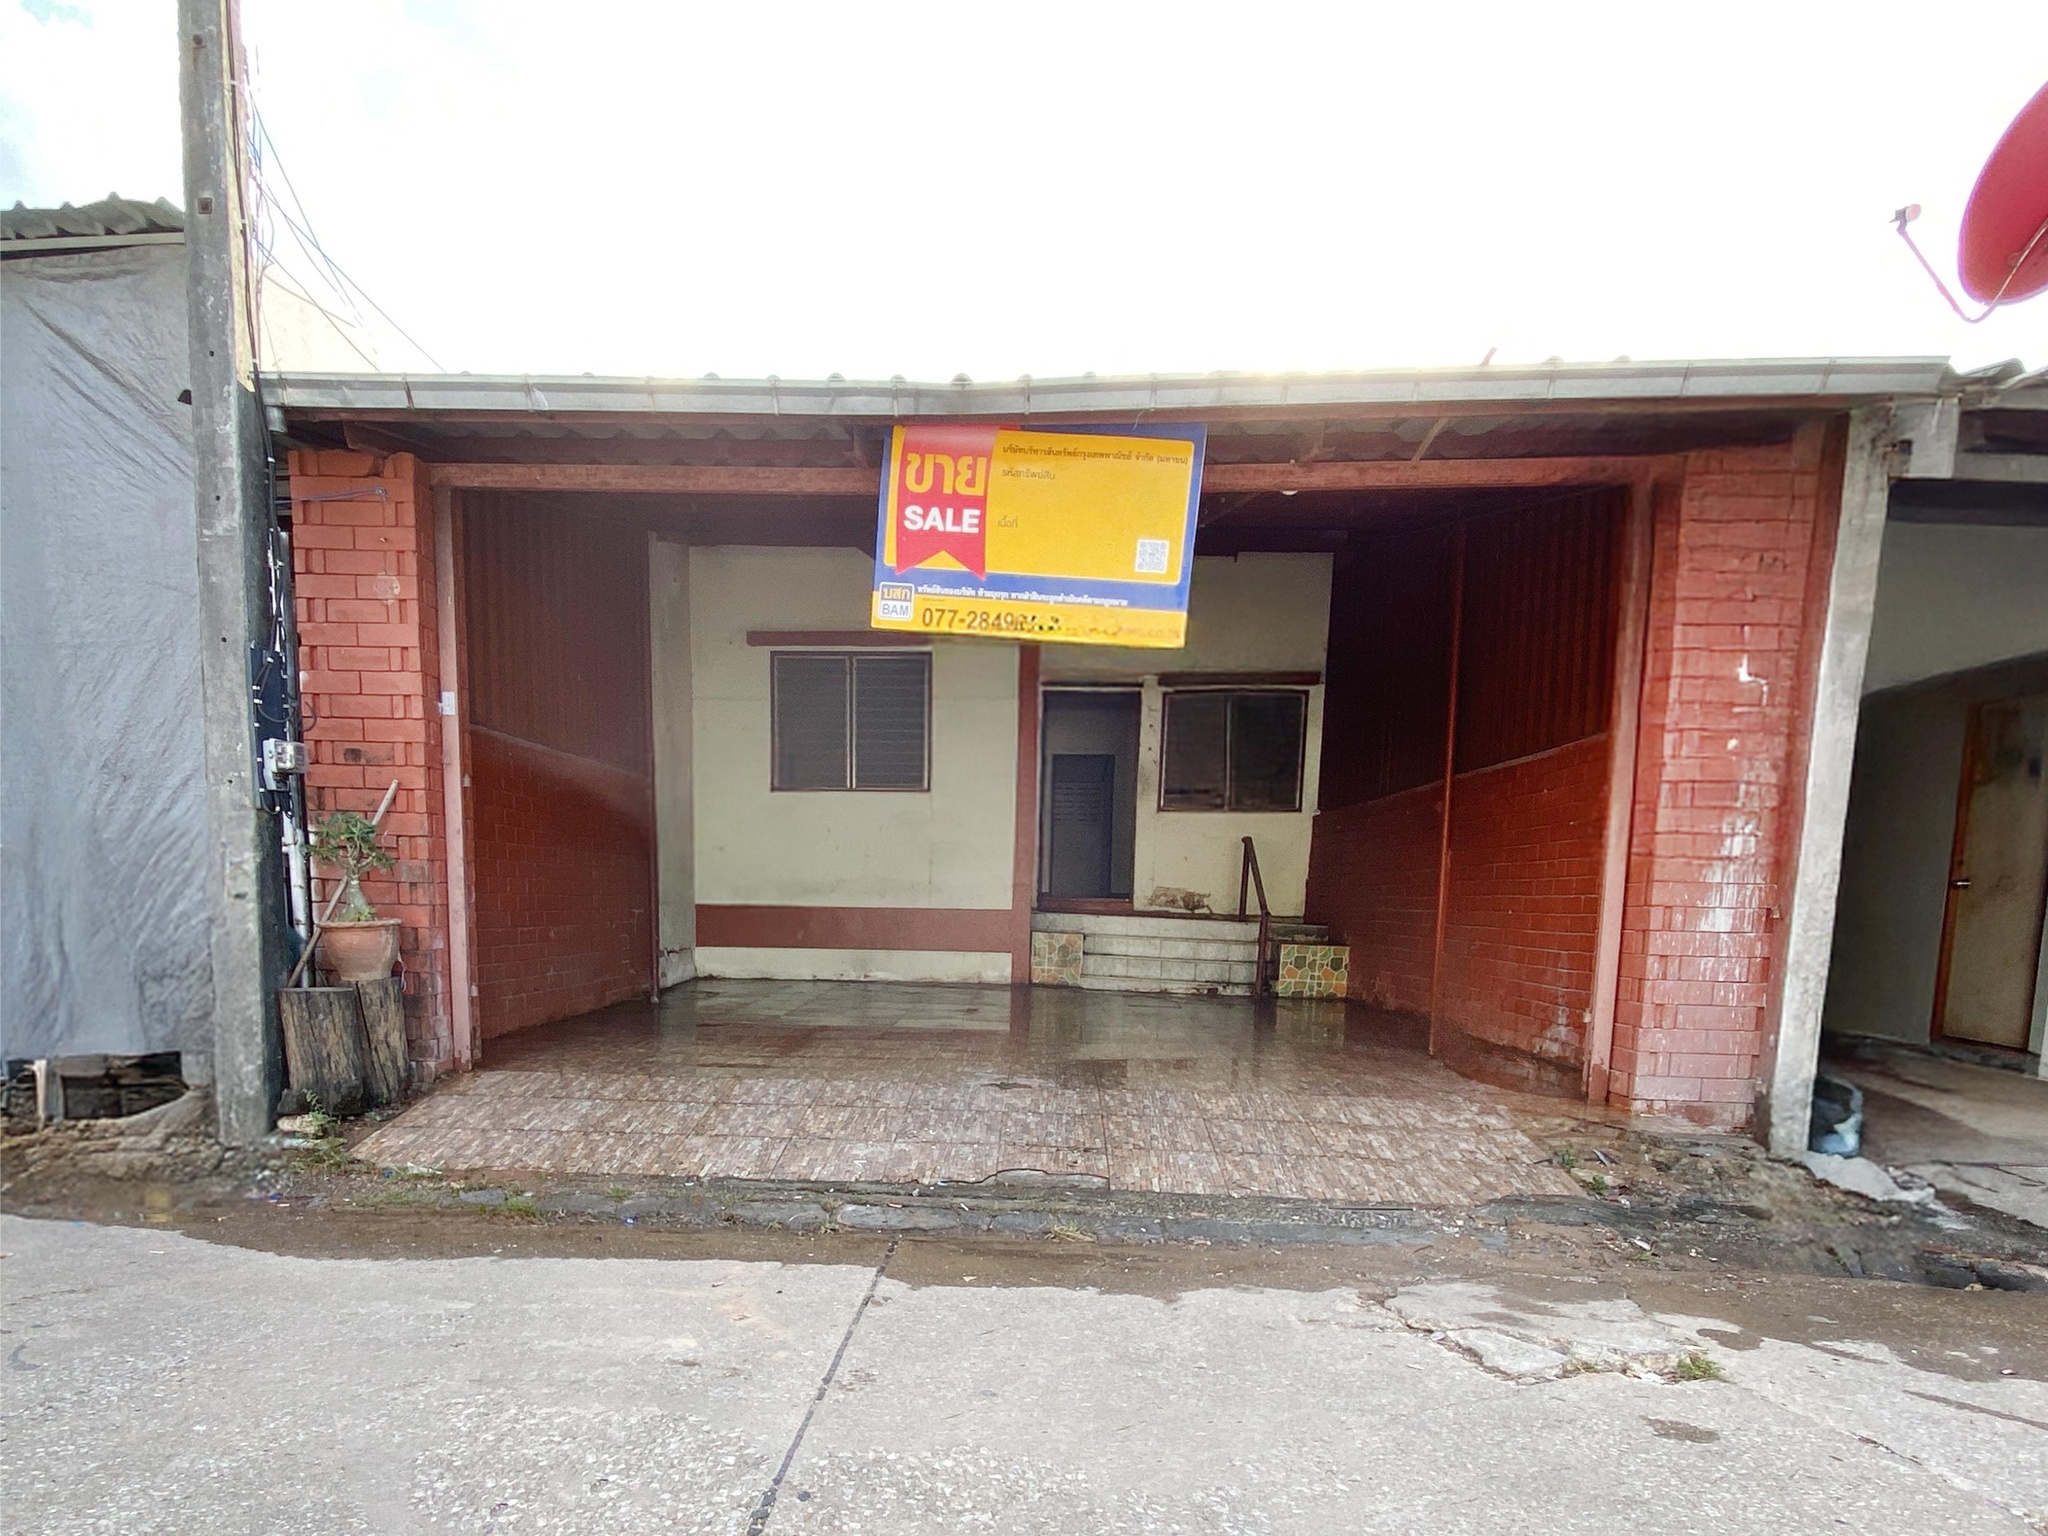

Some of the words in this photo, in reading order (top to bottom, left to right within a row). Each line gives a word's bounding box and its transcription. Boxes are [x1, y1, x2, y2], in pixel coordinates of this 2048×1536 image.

[905, 452, 987, 497] ขาย
[903, 505, 981, 533] SALE
[883, 586, 910, 600] บสก
[882, 603, 909, 617] BAM
